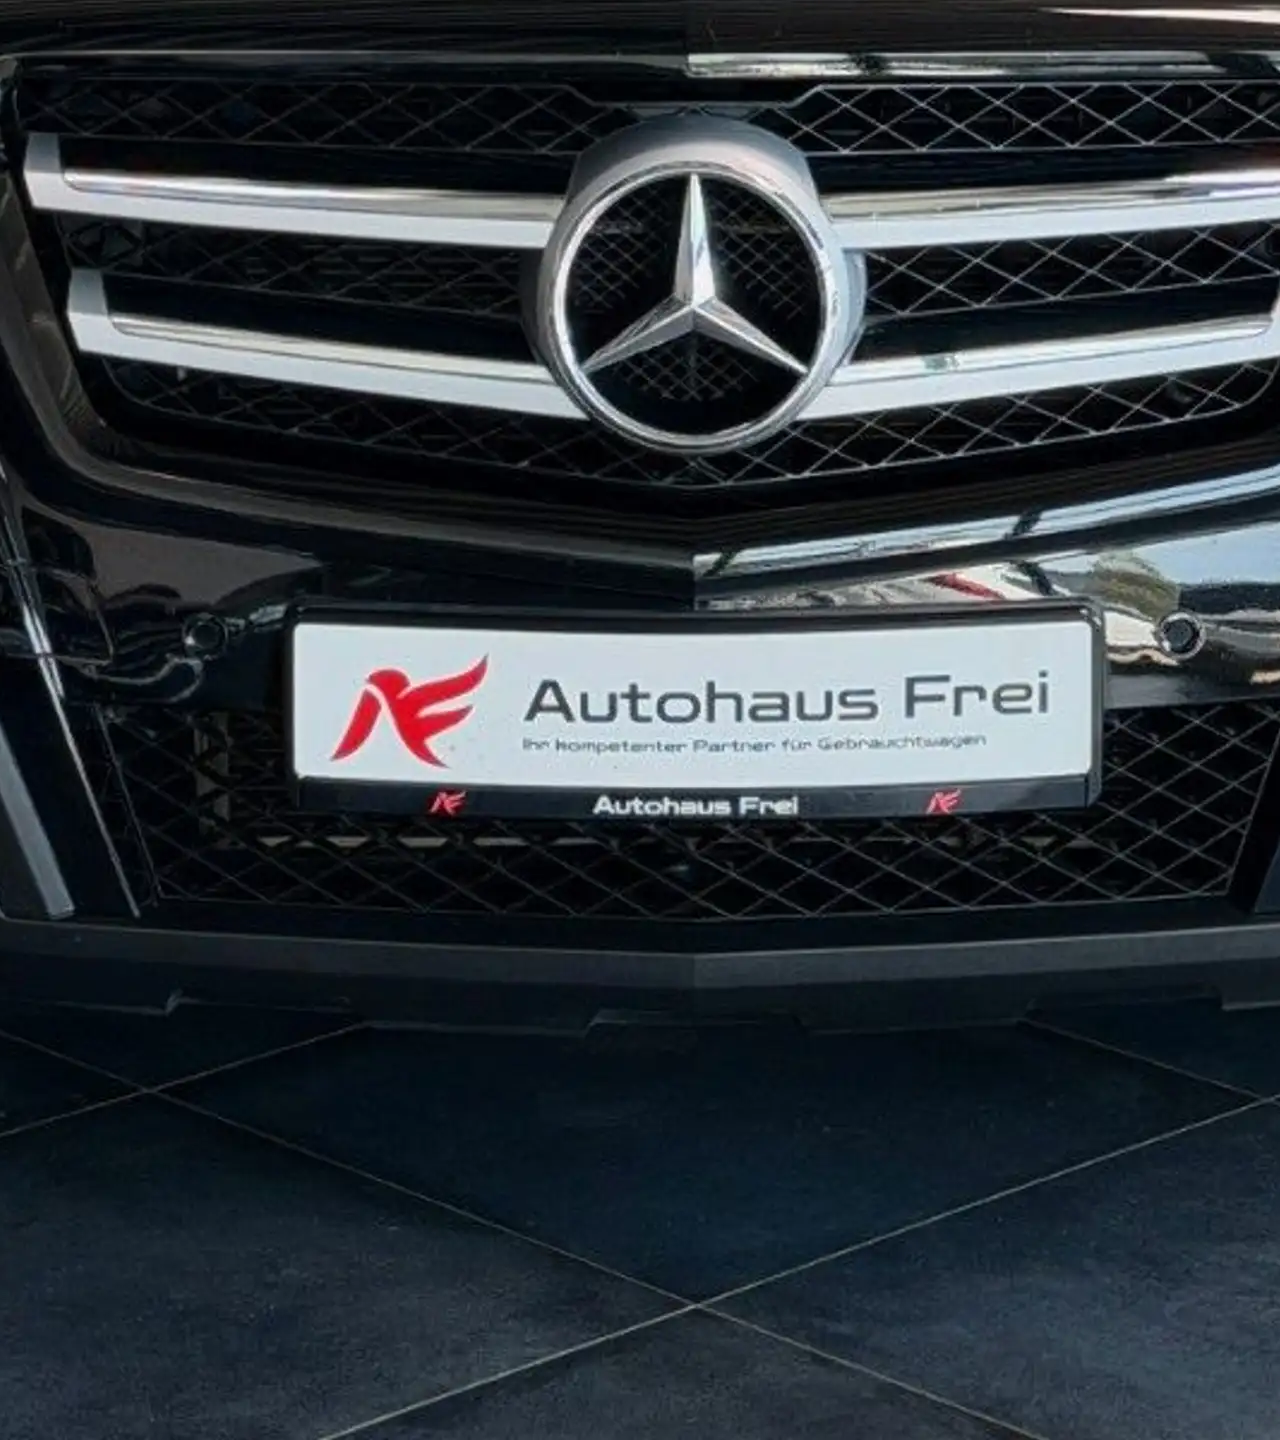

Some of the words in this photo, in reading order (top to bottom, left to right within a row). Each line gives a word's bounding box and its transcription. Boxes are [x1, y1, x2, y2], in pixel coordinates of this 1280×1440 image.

[523, 678, 880, 724] Autohaus
[904, 669, 1049, 719] Frei
[522, 737, 551, 751] Ihr
[555, 737, 687, 755] kompetenter
[692, 738, 776, 753] Partner
[781, 736, 813, 752] für
[817, 733, 987, 752] Gebrauchtwagen
[592, 794, 732, 816] Autohaus
[738, 795, 799, 816] Frei
